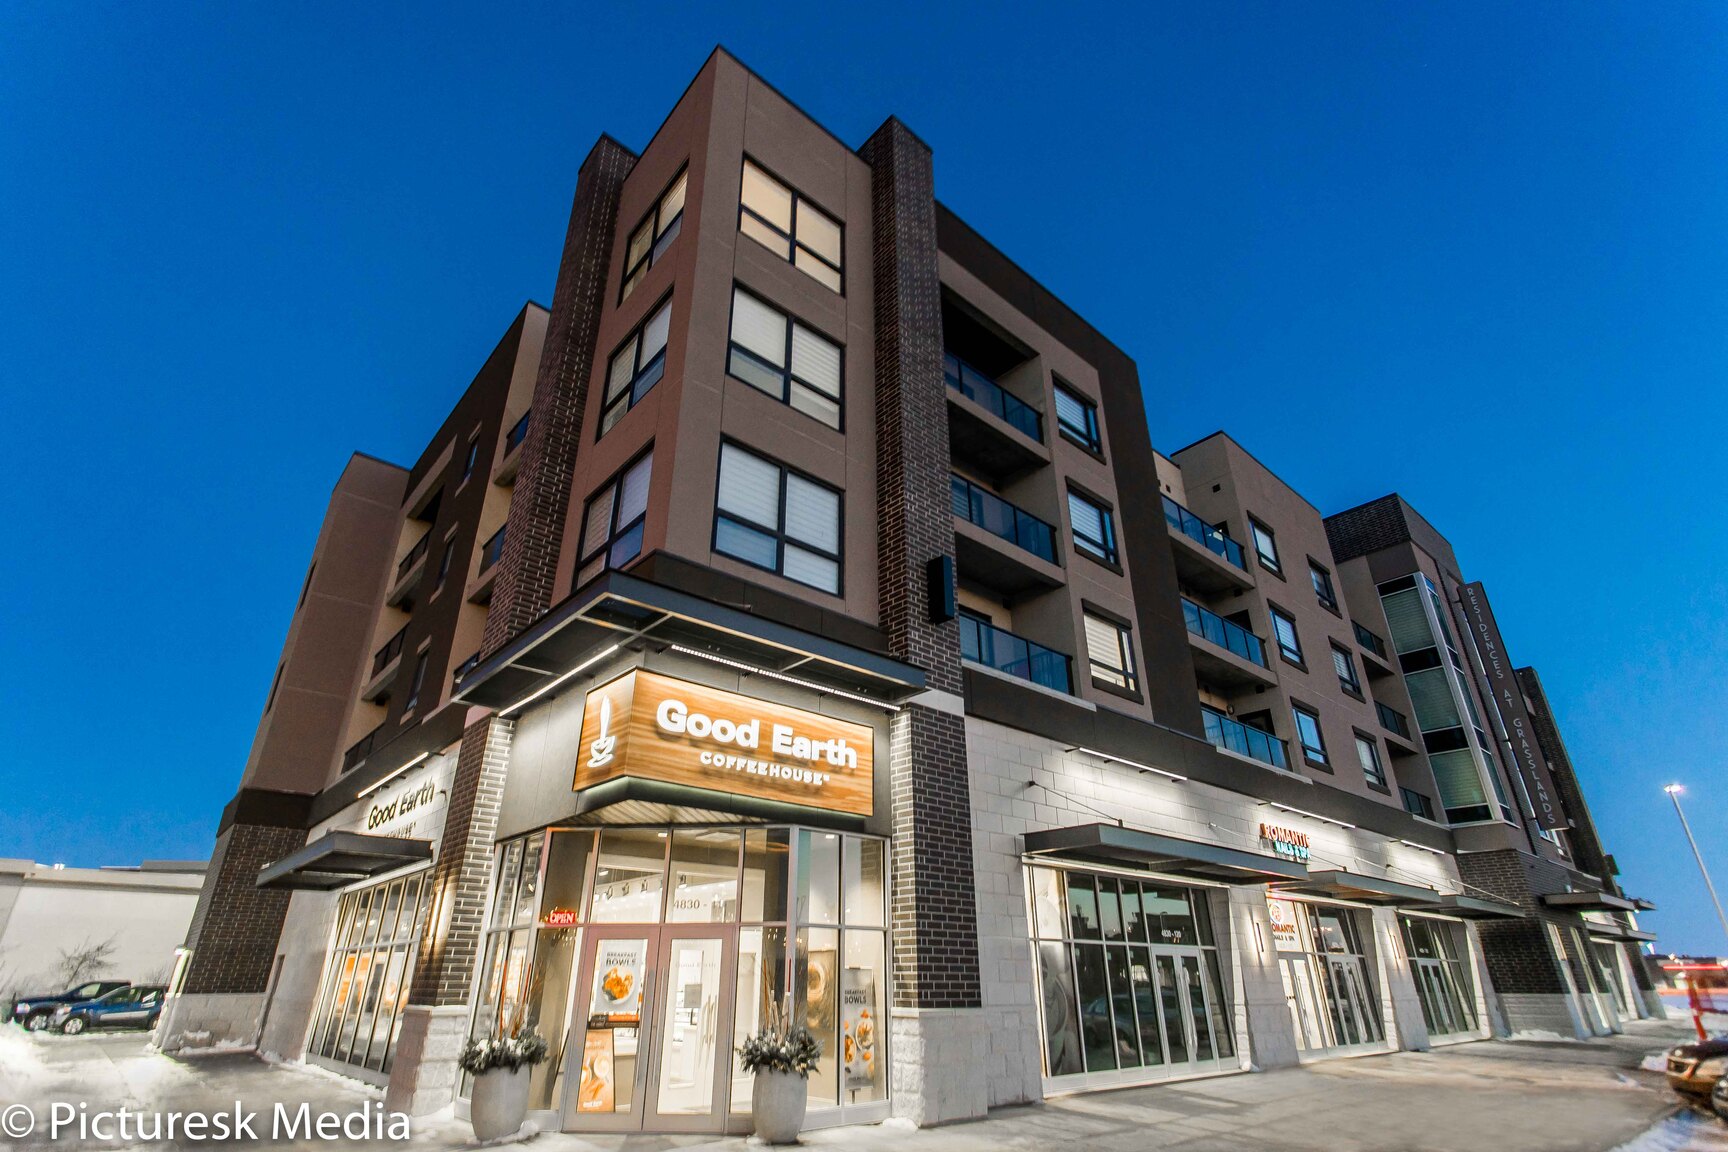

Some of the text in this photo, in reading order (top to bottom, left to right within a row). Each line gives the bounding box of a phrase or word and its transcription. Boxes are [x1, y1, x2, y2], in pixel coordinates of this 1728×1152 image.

[1466, 587, 1556, 824] RESIDENCES AT GRASSLANDS
[656, 699, 857, 769] Good Earth
[700, 751, 825, 785] COFFEEHOUSE
[367, 794, 400, 830] Good
[399, 776, 435, 816] Earth
[1260, 823, 1311, 849] ROMANTIC
[674, 899, 700, 909] 4830
[550, 912, 575, 924] OPEN
[1271, 923, 1295, 934] OMANTIC
[844, 996, 867, 1005] BOWLS
